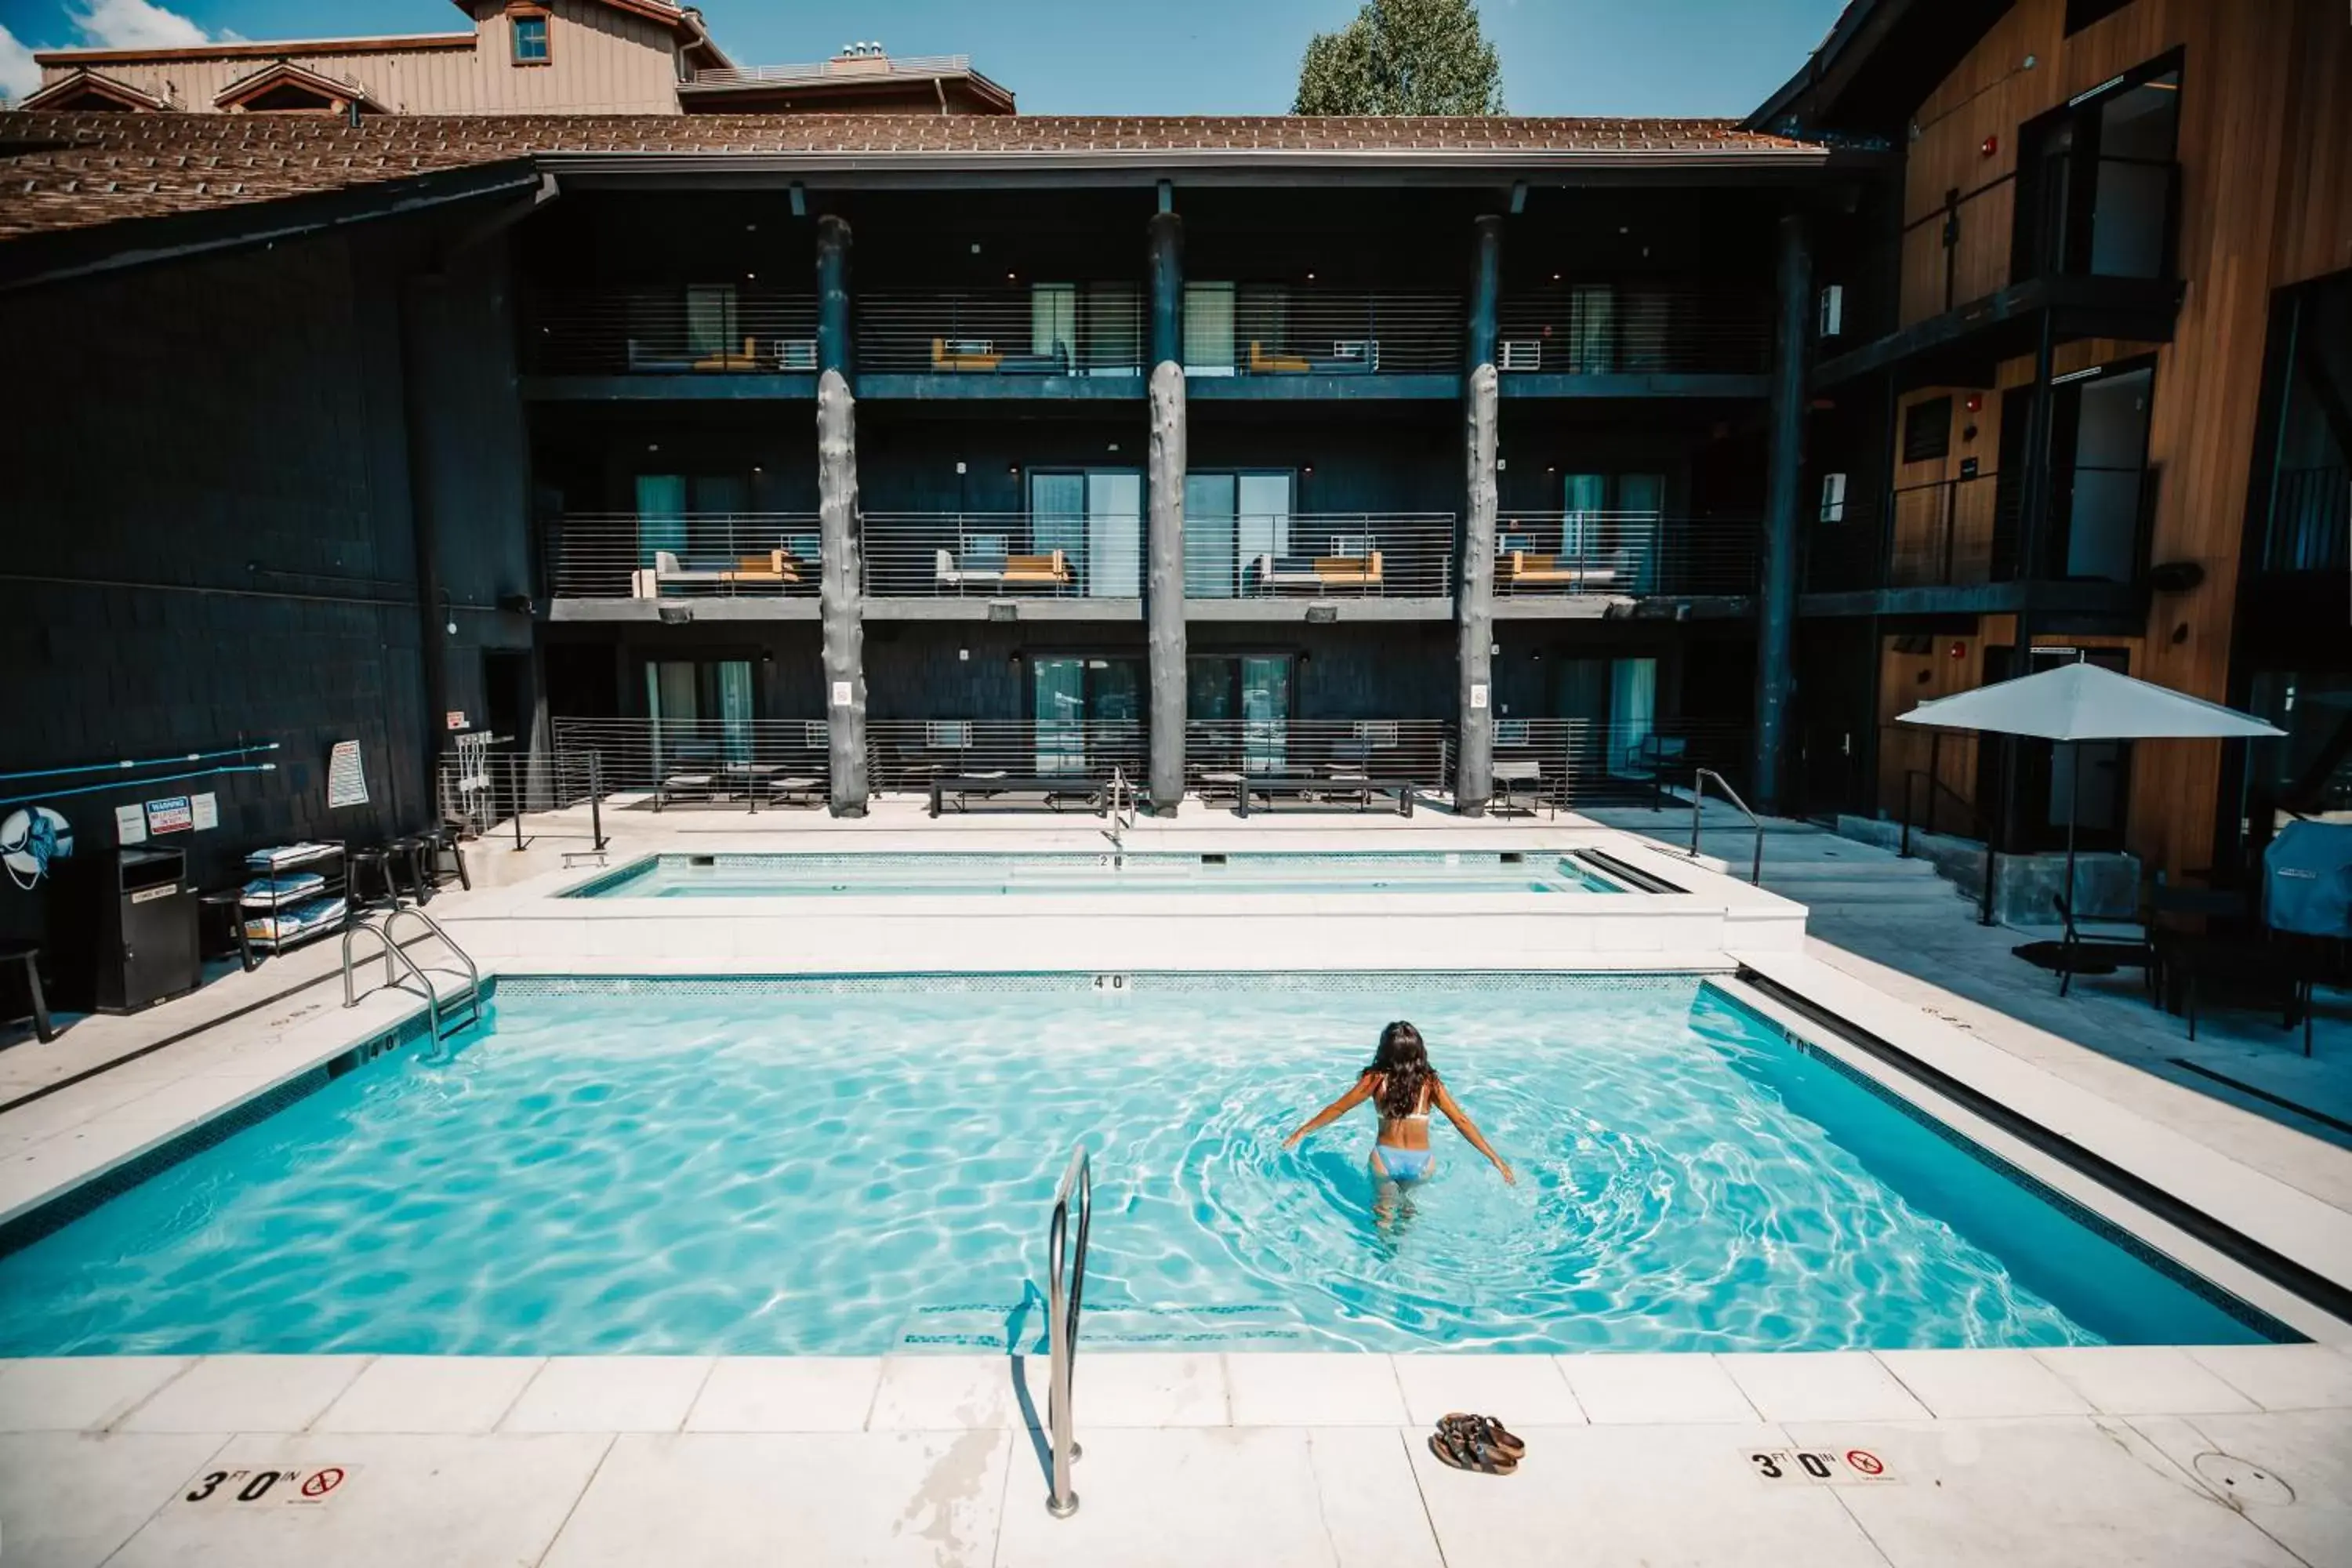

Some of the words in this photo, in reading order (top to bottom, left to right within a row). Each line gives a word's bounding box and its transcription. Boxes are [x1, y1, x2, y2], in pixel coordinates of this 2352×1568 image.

[151, 799, 184, 811] WARNING
[1094, 975, 1105, 989] 4
[1113, 975, 1123, 989] 0
[386, 1035, 394, 1051] 0
[1752, 1454, 1783, 1478] 3
[1797, 1453, 1832, 1478] 0
[227, 1470, 252, 1482] FT
[279, 1470, 302, 1482] IN
[186, 1470, 229, 1502] 3
[237, 1470, 281, 1502] 0
